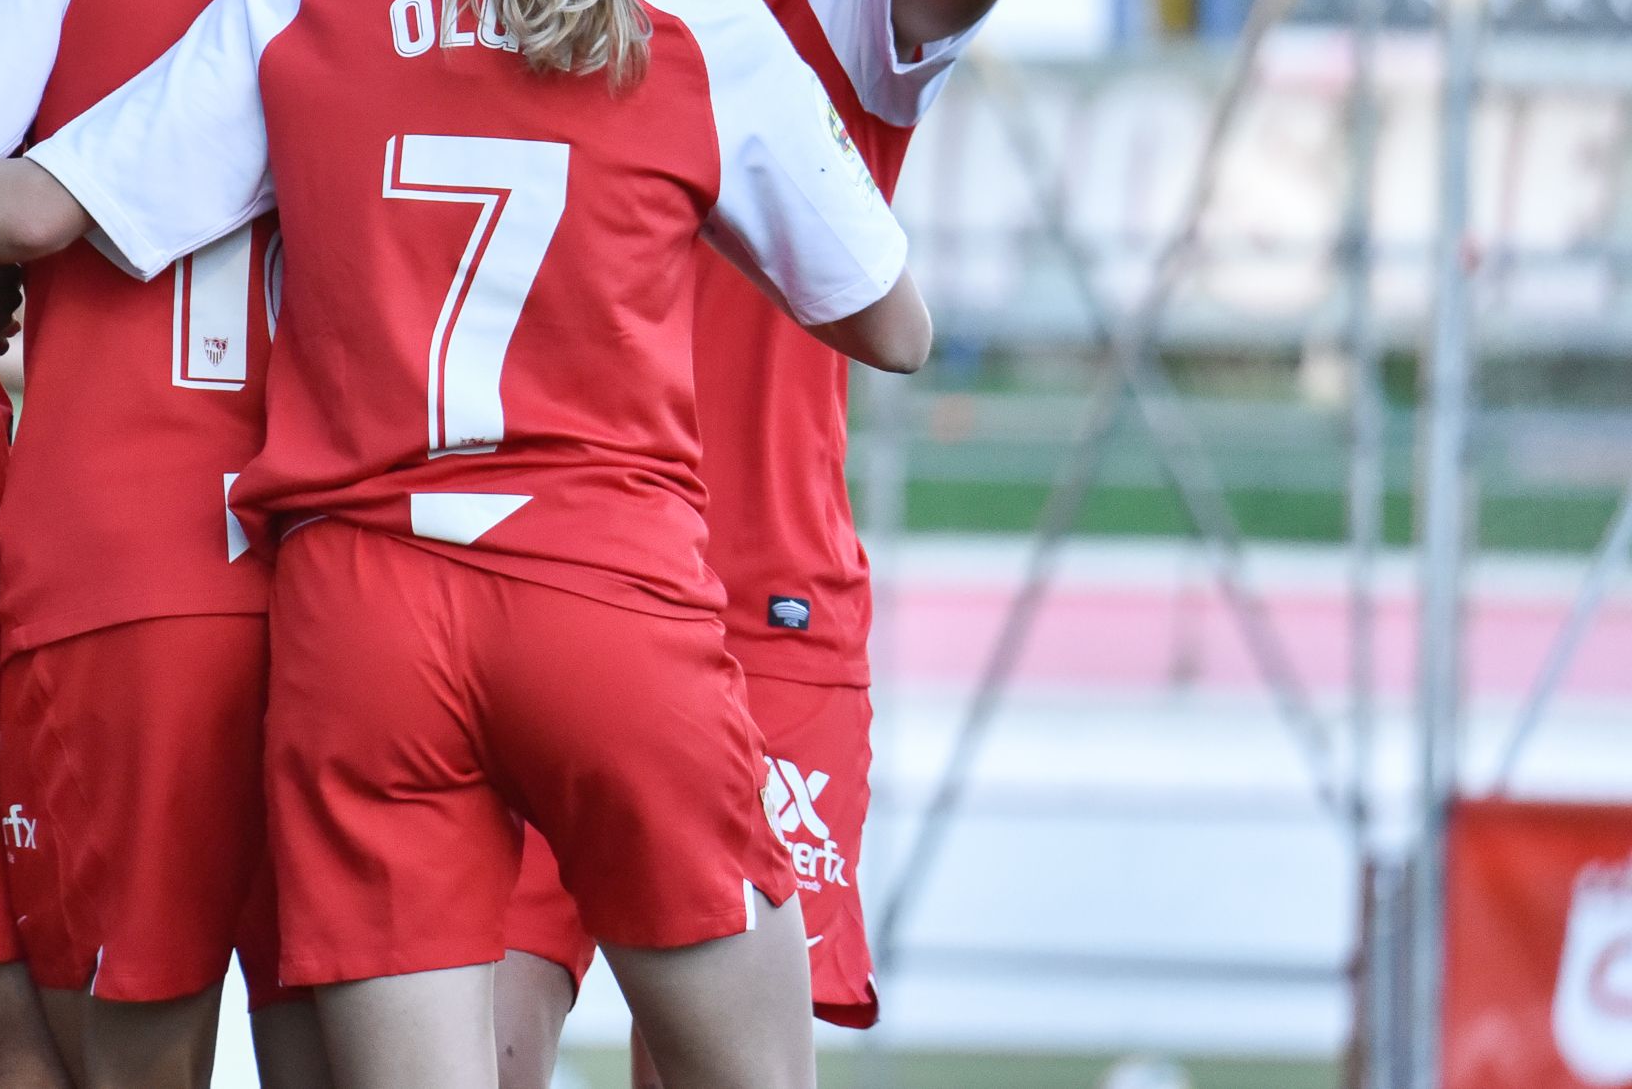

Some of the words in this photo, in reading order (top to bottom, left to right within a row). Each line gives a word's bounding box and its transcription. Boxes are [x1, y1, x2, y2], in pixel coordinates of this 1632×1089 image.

[172, 221, 283, 393] 1
[381, 133, 570, 460] 7
[785, 839, 850, 888] erfx
